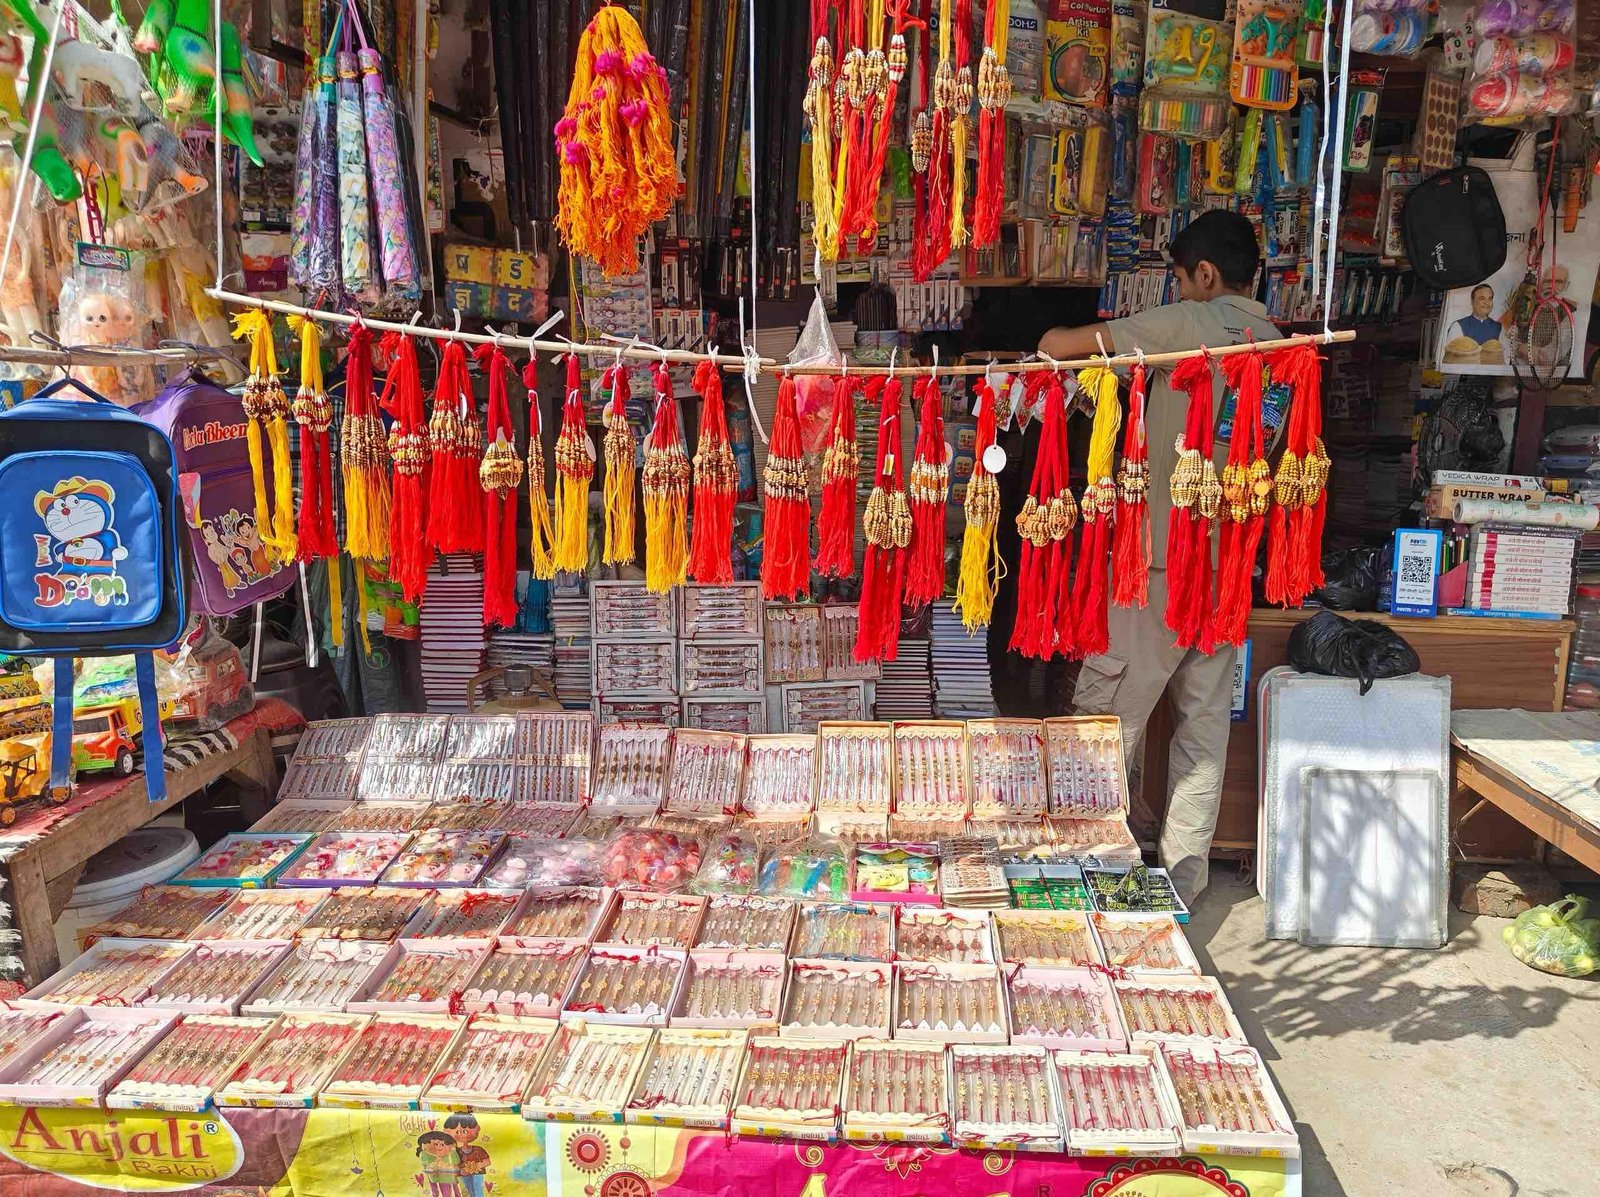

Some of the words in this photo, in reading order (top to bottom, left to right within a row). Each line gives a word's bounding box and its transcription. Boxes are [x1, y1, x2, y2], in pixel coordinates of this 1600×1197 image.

[1066, 17, 1099, 28] Artista
[1076, 26, 1089, 37] Kit
[1442, 472, 1472, 480] VEDICA
[1452, 489, 1494, 500] BUTTER
[1498, 492, 1532, 502] WRAP
[10, 1107, 209, 1162] Anjali
[132, 1160, 218, 1178] Rakhi
